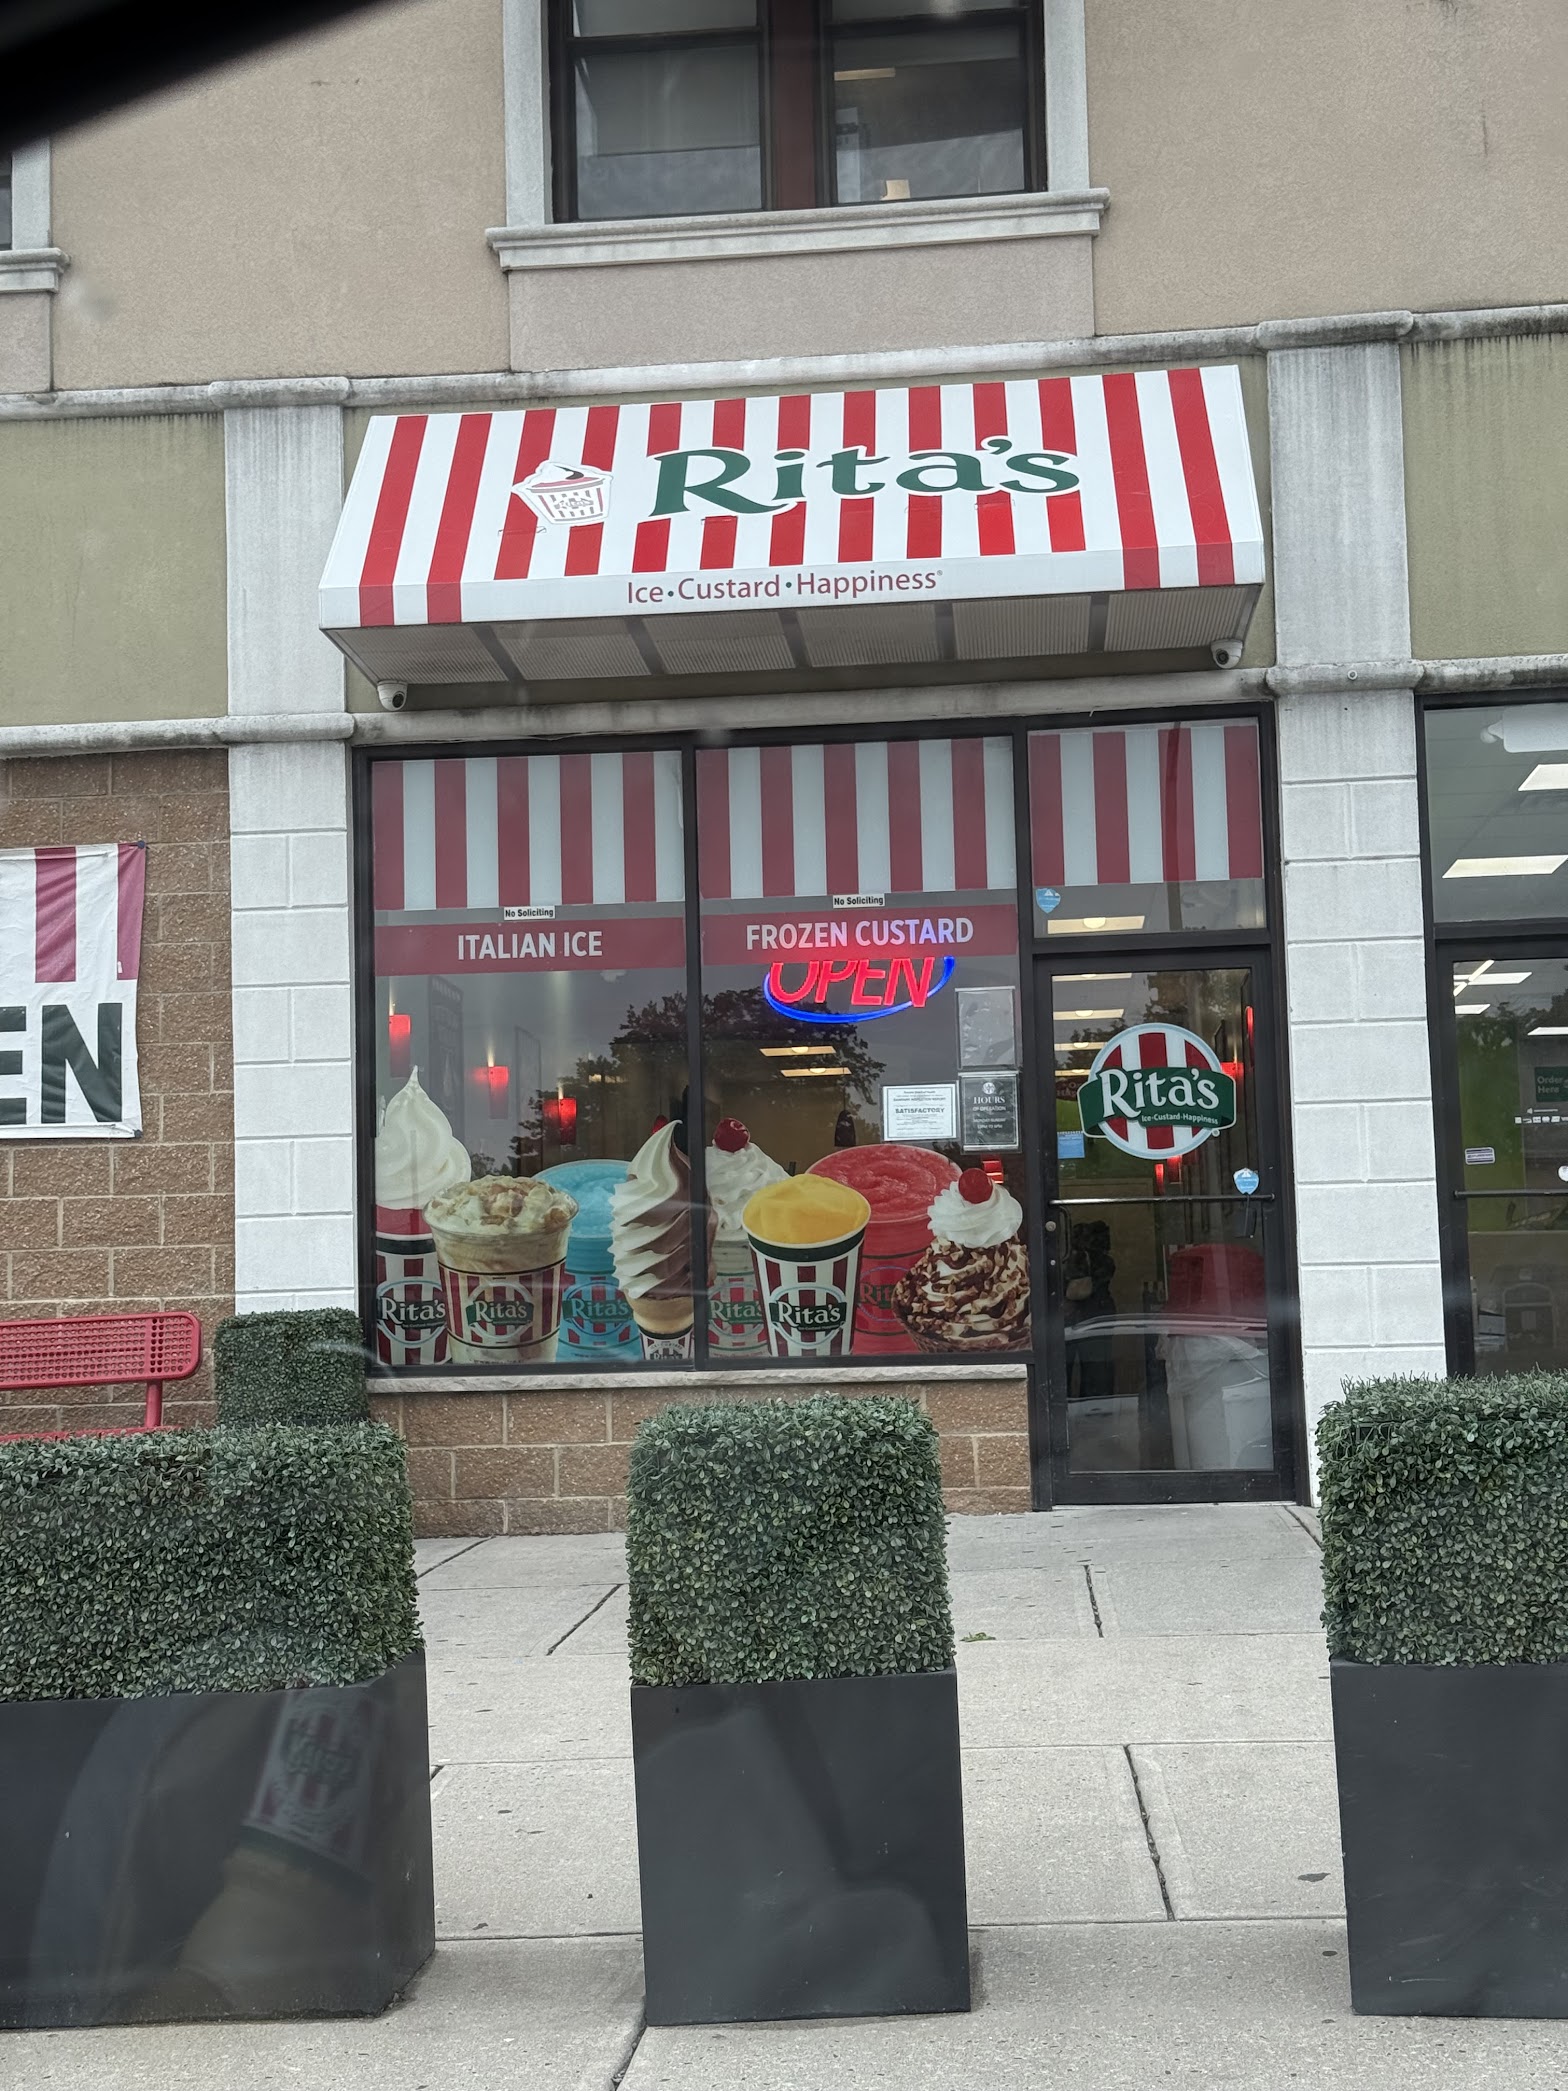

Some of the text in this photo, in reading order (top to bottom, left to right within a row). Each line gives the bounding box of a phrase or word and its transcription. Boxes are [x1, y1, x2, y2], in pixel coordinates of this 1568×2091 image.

[648, 438, 1081, 518] Rita's
[627, 582, 664, 604] Ice
[677, 574, 781, 600] Custard
[505, 907, 554, 918] No Soliciting
[833, 895, 884, 907] No Soliciting
[458, 930, 603, 960] ITALIAN ICE
[746, 917, 974, 950] FROZEN CUSTARD
[769, 957, 936, 1007] OPEN
[1537, 1075, 1563, 1084] Order
[1537, 1085, 1560, 1094] Here
[973, 1096, 1006, 1104] HOURS
[1099, 1067, 1219, 1118] Rita's
[1153, 1113, 1181, 1121] Custard
[1182, 1113, 1219, 1125] Happiness
[381, 1297, 446, 1324] Rita's
[475, 1300, 528, 1322] Rita's
[571, 1297, 630, 1319] Rita's
[778, 1301, 841, 1327] Rita's
